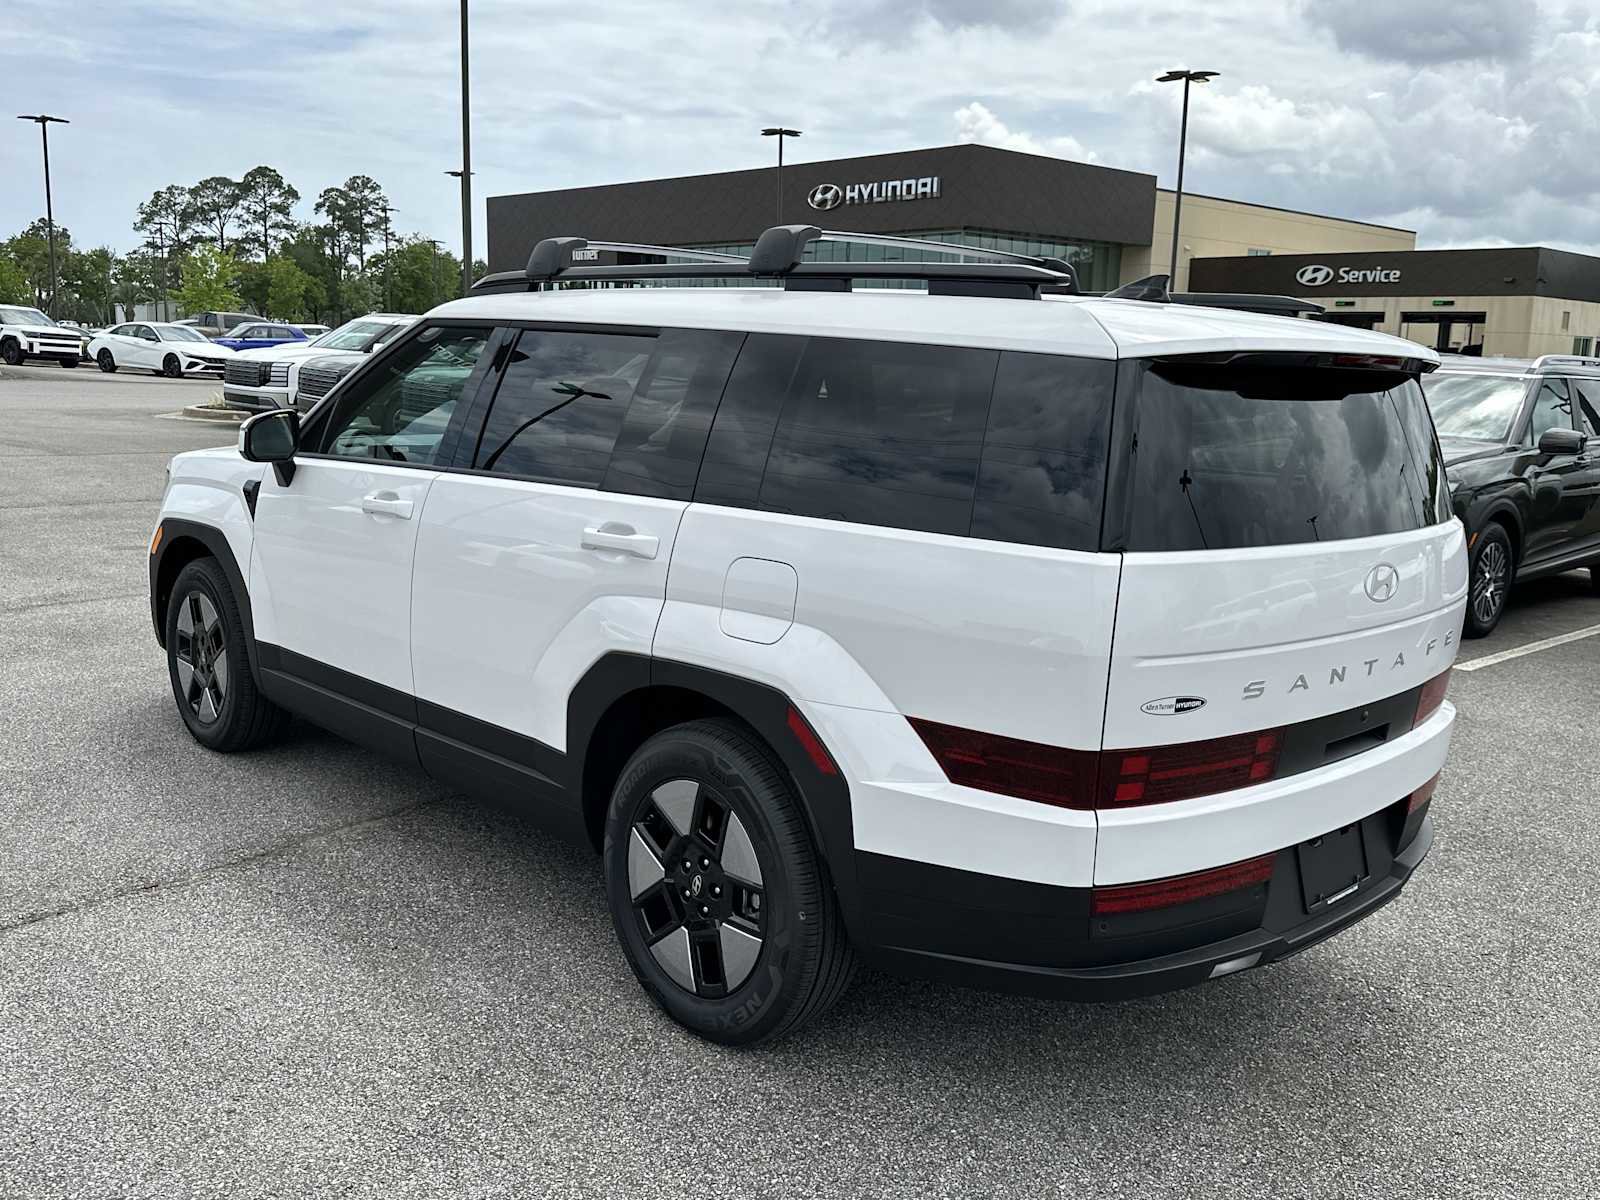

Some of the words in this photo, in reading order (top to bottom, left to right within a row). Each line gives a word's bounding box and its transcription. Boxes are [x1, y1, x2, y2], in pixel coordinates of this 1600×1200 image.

[845, 176, 940, 204] HYUNDAI
[1337, 266, 1401, 283] Service
[1241, 652, 1405, 700] SANTA
[1425, 630, 1454, 656] FE
